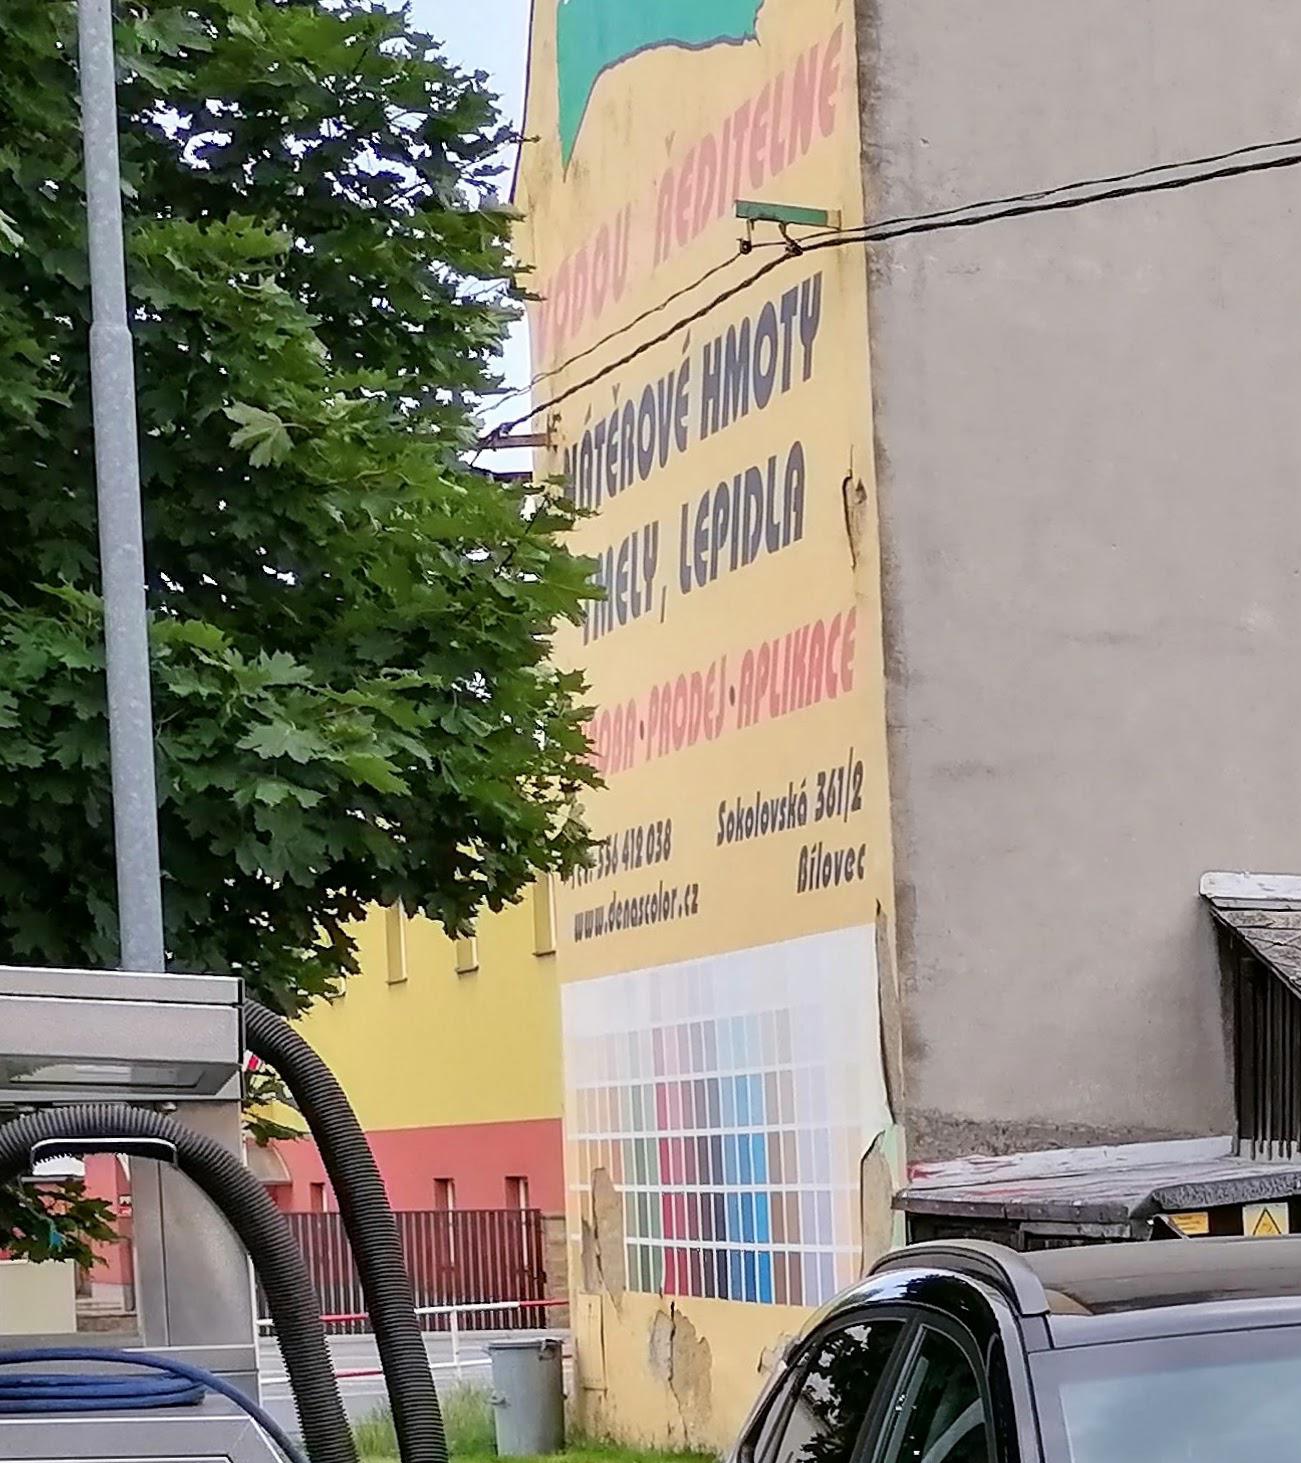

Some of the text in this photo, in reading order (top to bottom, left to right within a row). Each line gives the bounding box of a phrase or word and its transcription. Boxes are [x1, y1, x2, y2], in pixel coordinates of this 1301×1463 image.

[700, 271, 823, 440] HMOTY
[680, 440, 805, 595] LEPIDLA
[736, 606, 857, 731] APLIKACE
[646, 818, 672, 866] 038
[716, 746, 864, 847] Sokolovská 361/2
[796, 842, 867, 894] Bílovec
